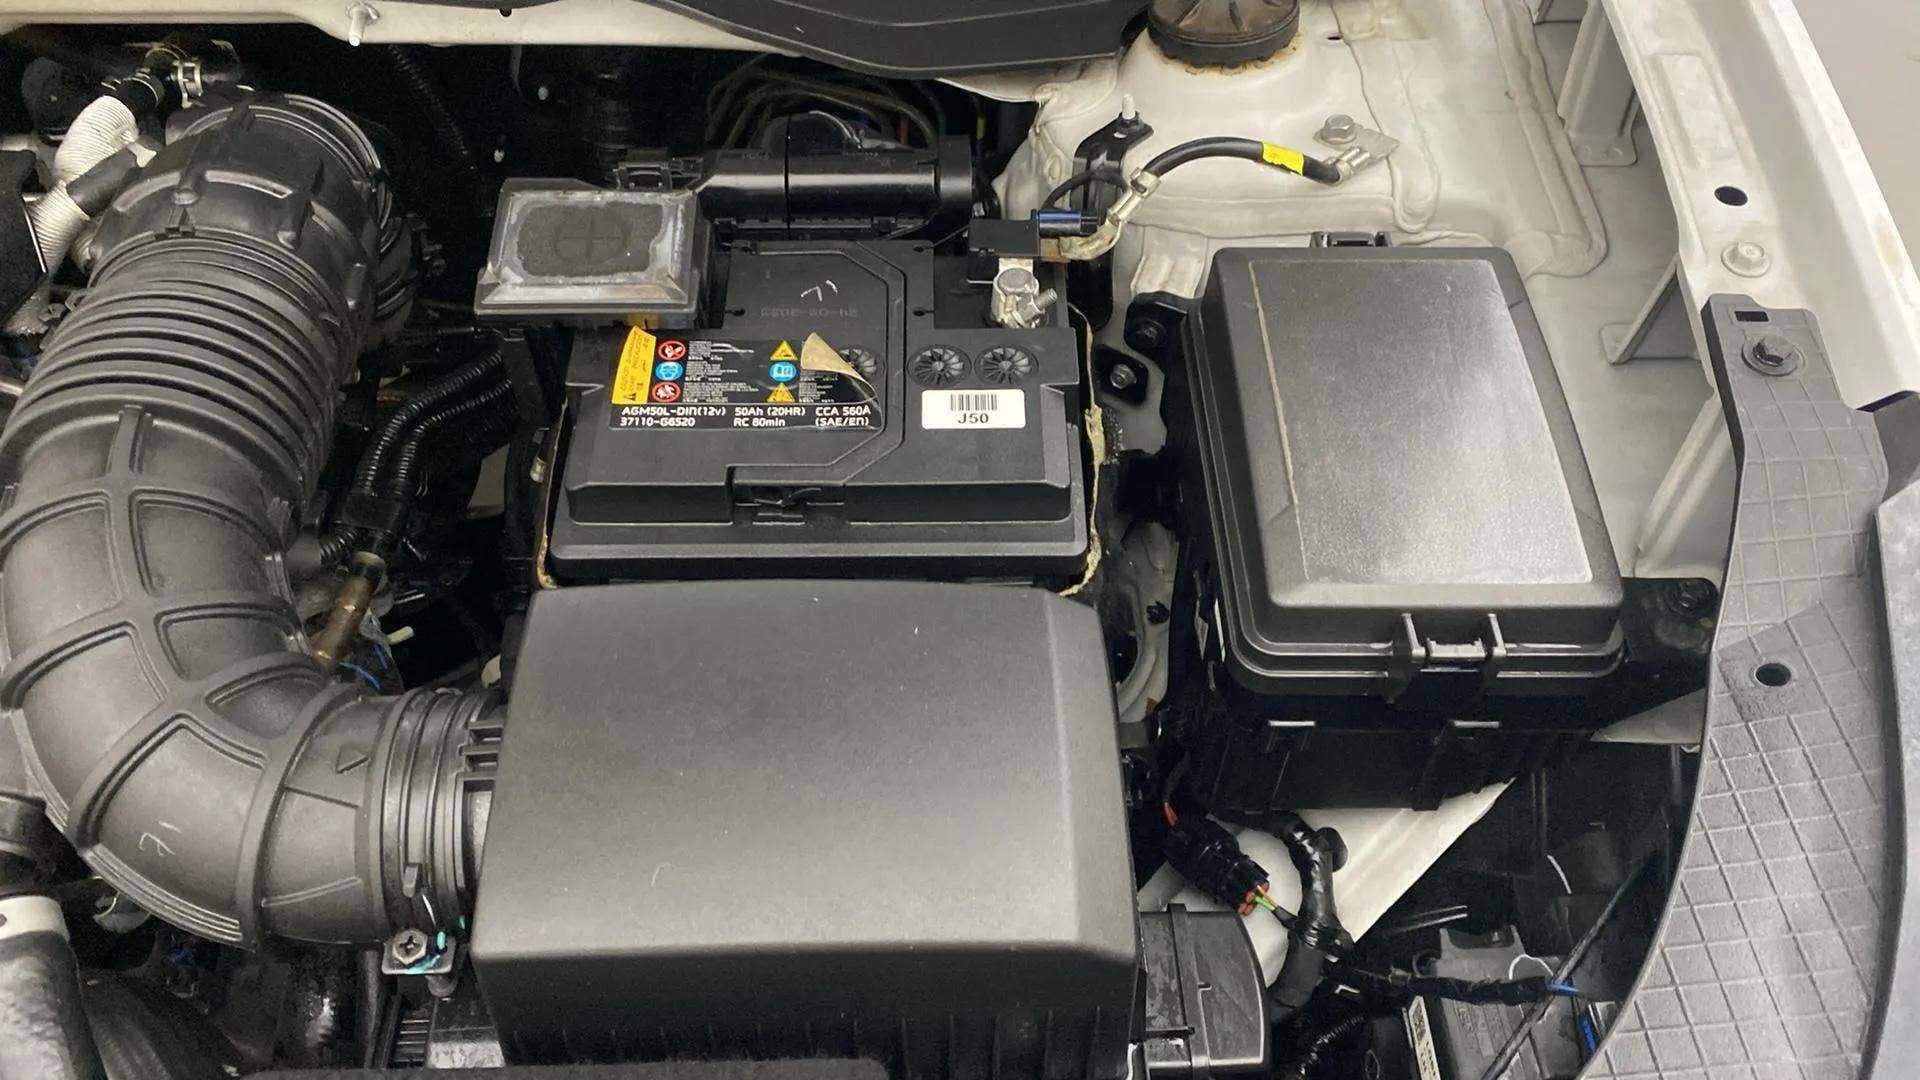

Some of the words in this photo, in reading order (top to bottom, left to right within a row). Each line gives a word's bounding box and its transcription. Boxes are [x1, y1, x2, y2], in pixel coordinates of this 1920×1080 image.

[734, 406, 763, 416] 50Ah
[766, 406, 805, 417] (20HR)
[815, 406, 839, 416] CCA
[842, 405, 871, 416] 560A
[619, 417, 696, 427] 37110-G6520
[733, 417, 749, 427] RC
[752, 417, 786, 427] 80min
[957, 413, 989, 424] J50
